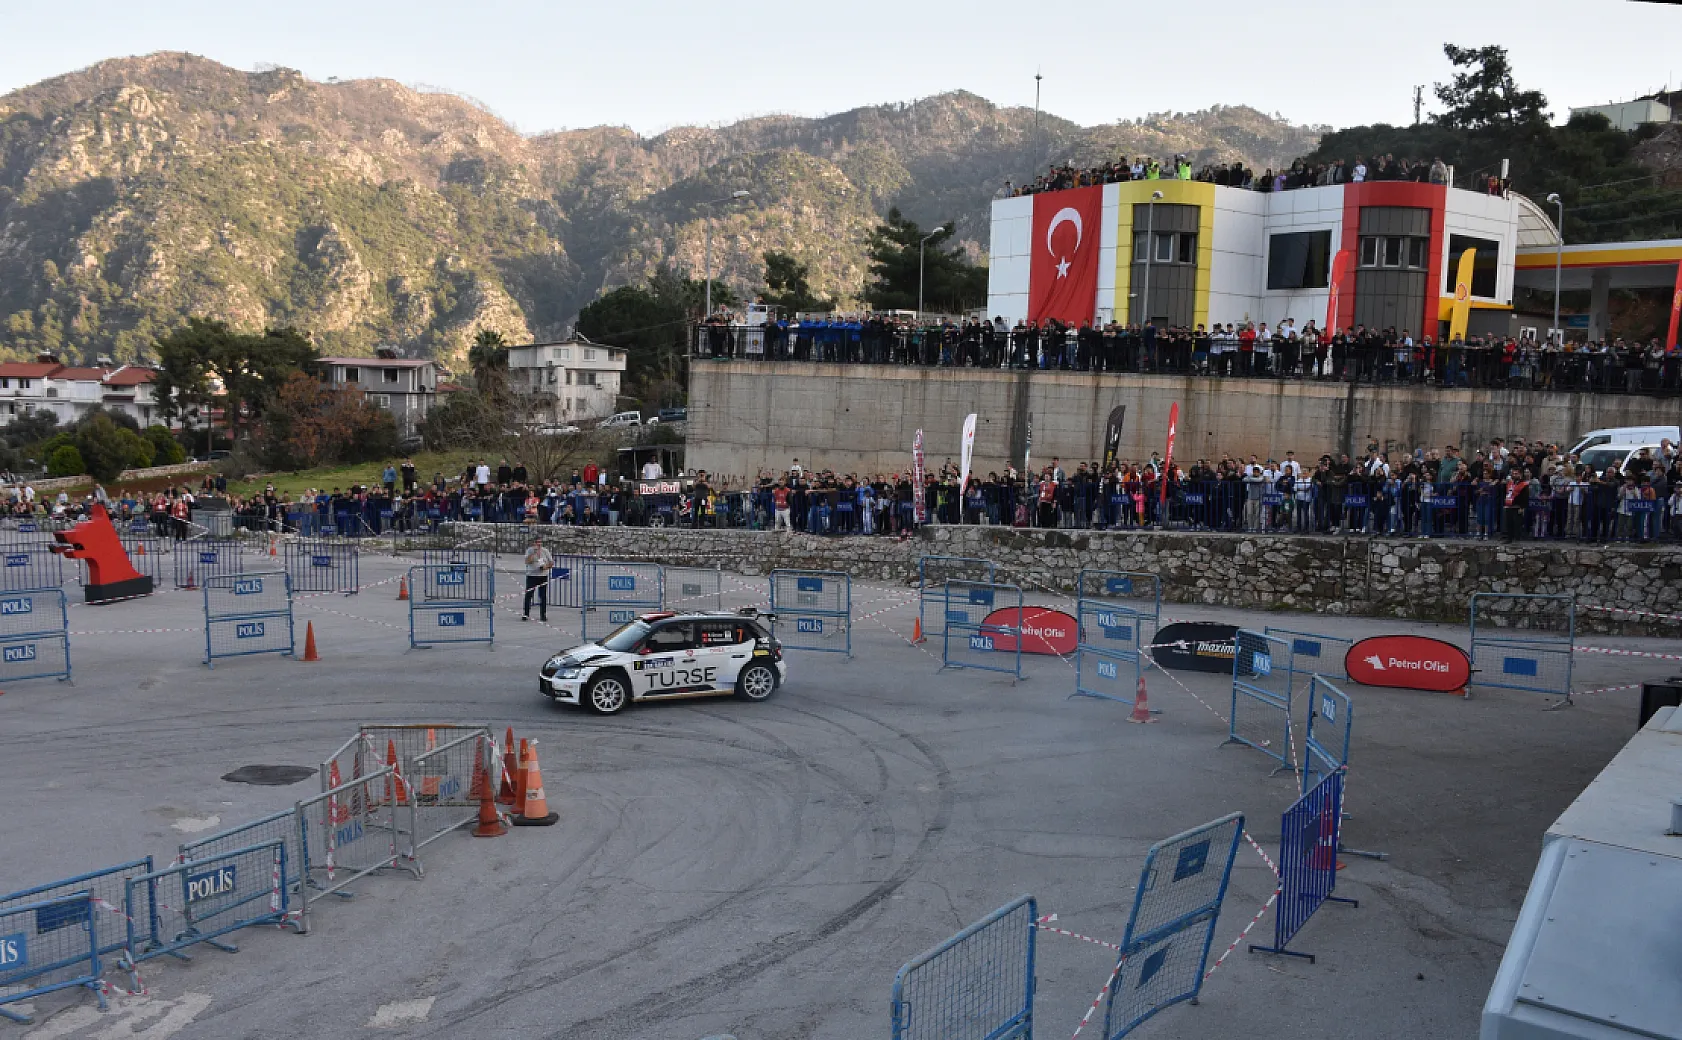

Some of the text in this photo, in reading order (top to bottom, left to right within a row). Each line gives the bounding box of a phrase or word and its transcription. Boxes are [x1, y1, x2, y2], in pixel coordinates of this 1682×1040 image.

[640, 482, 680, 495] Red Bull
[236, 580, 261, 593] POLİS
[610, 577, 632, 588] POLİS
[2, 599, 31, 613] POLİS
[239, 623, 263, 637] POLİS
[798, 620, 821, 632] POLİS
[736, 628, 745, 644] 7
[971, 636, 993, 649] POLİS
[5, 645, 35, 661] POLİS
[1388, 657, 1449, 672] Petrol Ofisi
[644, 666, 717, 689] TURSE
[337, 820, 364, 847] POLİS
[188, 869, 234, 902] POLİS
